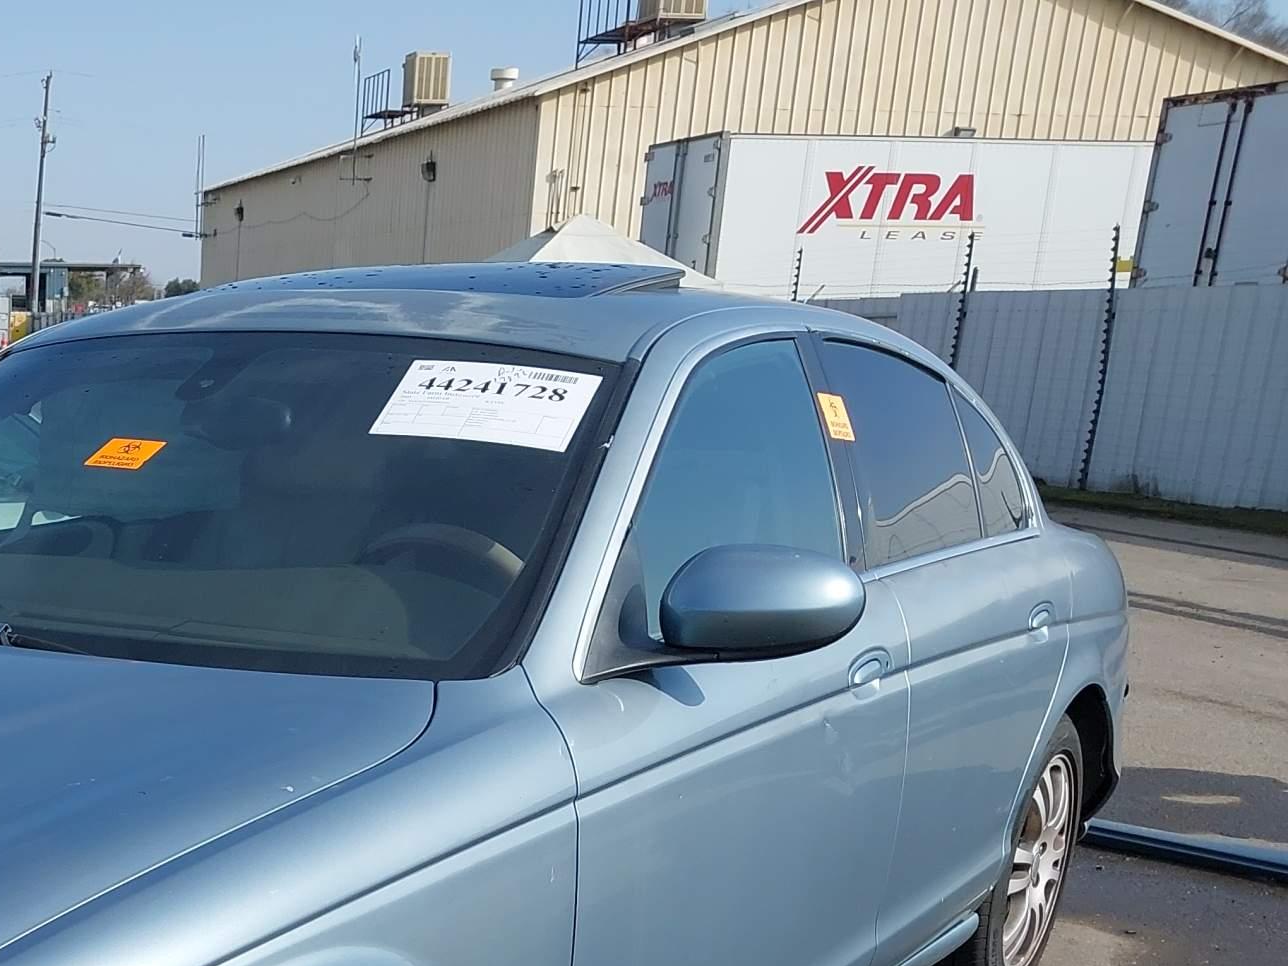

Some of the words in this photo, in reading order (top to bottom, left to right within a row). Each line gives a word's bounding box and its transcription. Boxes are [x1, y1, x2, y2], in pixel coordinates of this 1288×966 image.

[796, 166, 975, 234] XTRA
[859, 230, 984, 241] LEASE
[418, 377, 568, 401] 44241728
